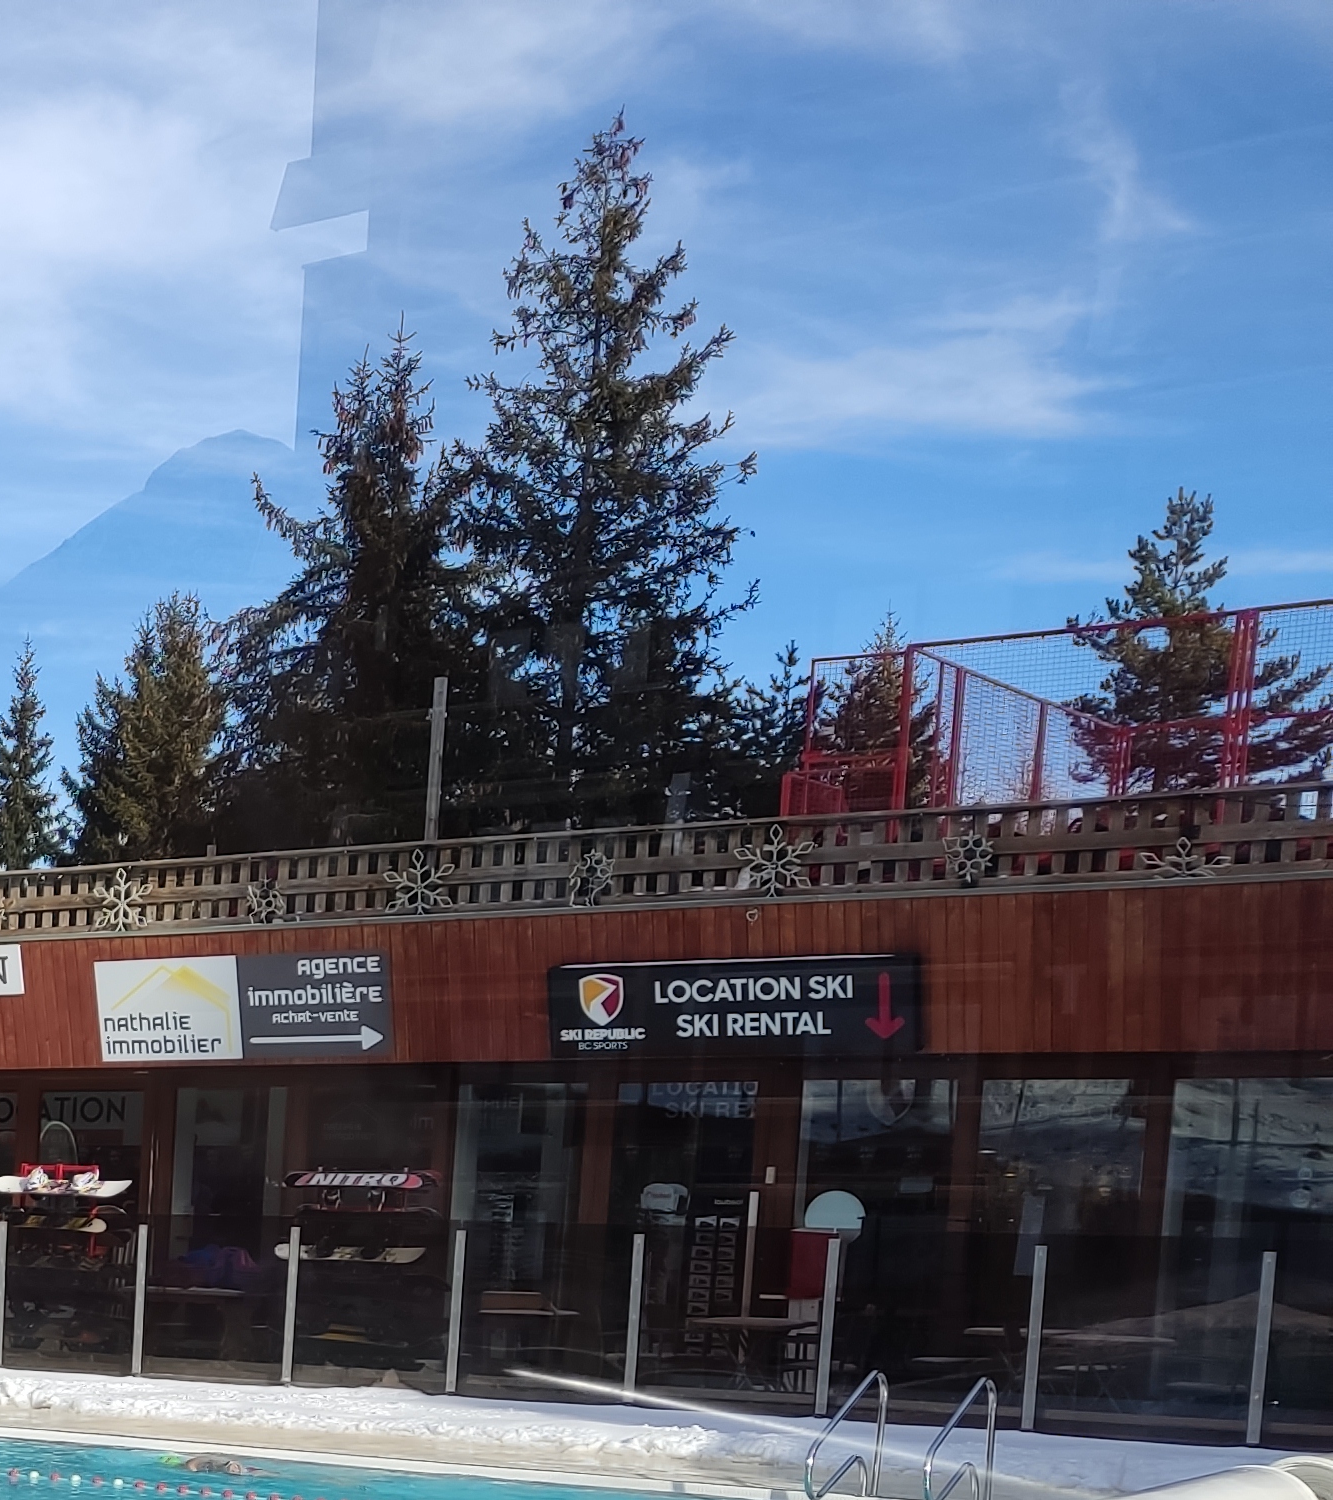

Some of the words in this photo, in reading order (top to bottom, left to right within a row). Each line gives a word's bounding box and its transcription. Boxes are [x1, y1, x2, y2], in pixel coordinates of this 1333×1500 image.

[654, 976, 801, 1004] LOCATION
[808, 974, 854, 999] SKI
[676, 1013, 719, 1038] SKI
[726, 1011, 832, 1036] RENTAL
[560, 1029, 583, 1042] SKI
[584, 1028, 646, 1041] REPUBLIC
[105, 1035, 222, 1056] immobilier
[593, 1041, 628, 1050] SPORTS
[310, 1172, 409, 1187] NITRO
